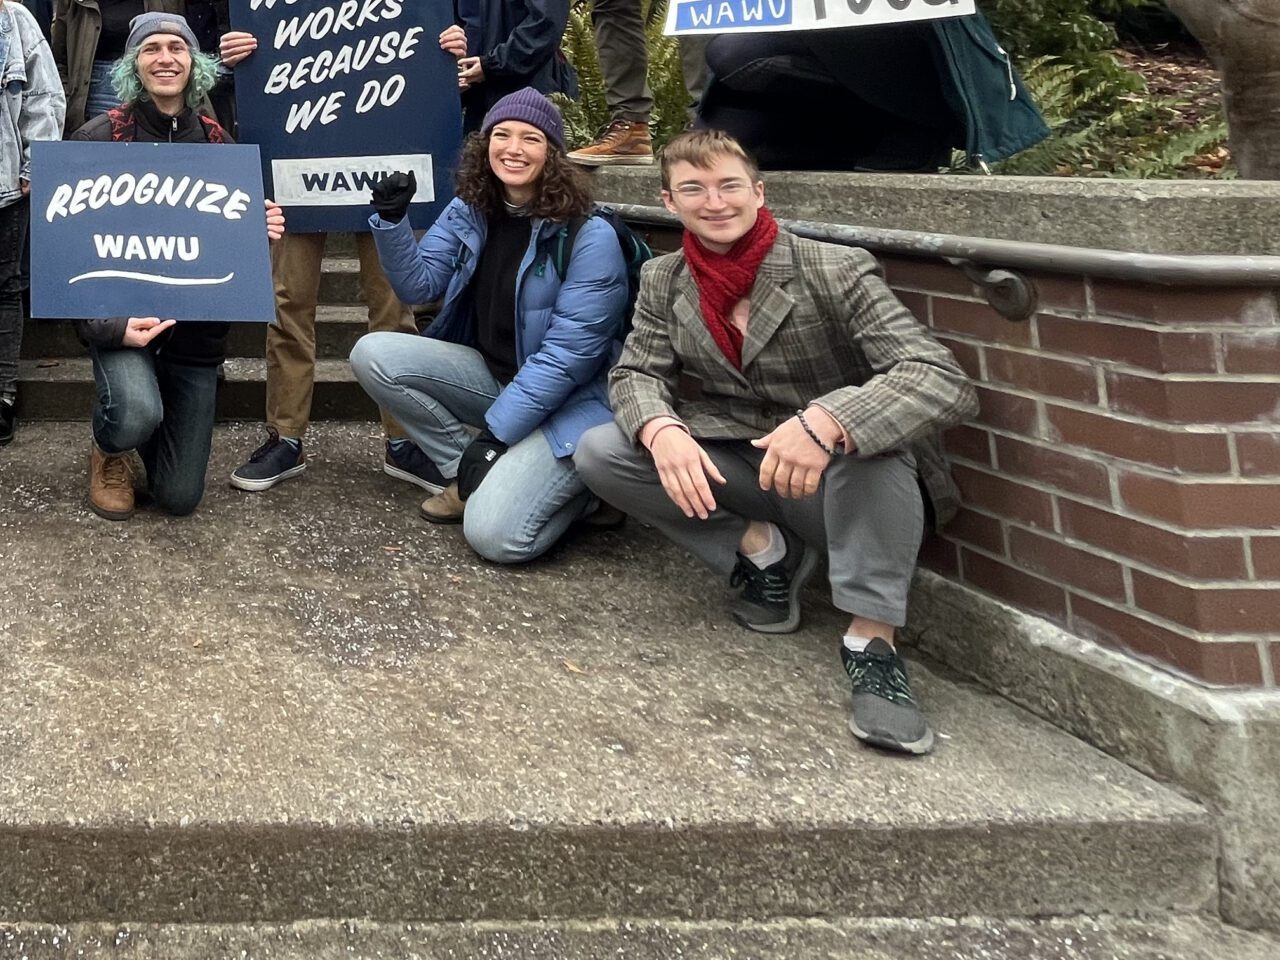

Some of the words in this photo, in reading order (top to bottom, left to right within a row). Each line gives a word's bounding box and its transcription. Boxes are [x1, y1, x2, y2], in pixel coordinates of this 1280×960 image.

[264, 26, 425, 96] BECAUSE
[284, 90, 346, 135] WE
[355, 74, 406, 114] DO
[45, 172, 251, 223] RECOGNIZE
[302, 170, 400, 192] WAW
[93, 234, 200, 262] WAWU
